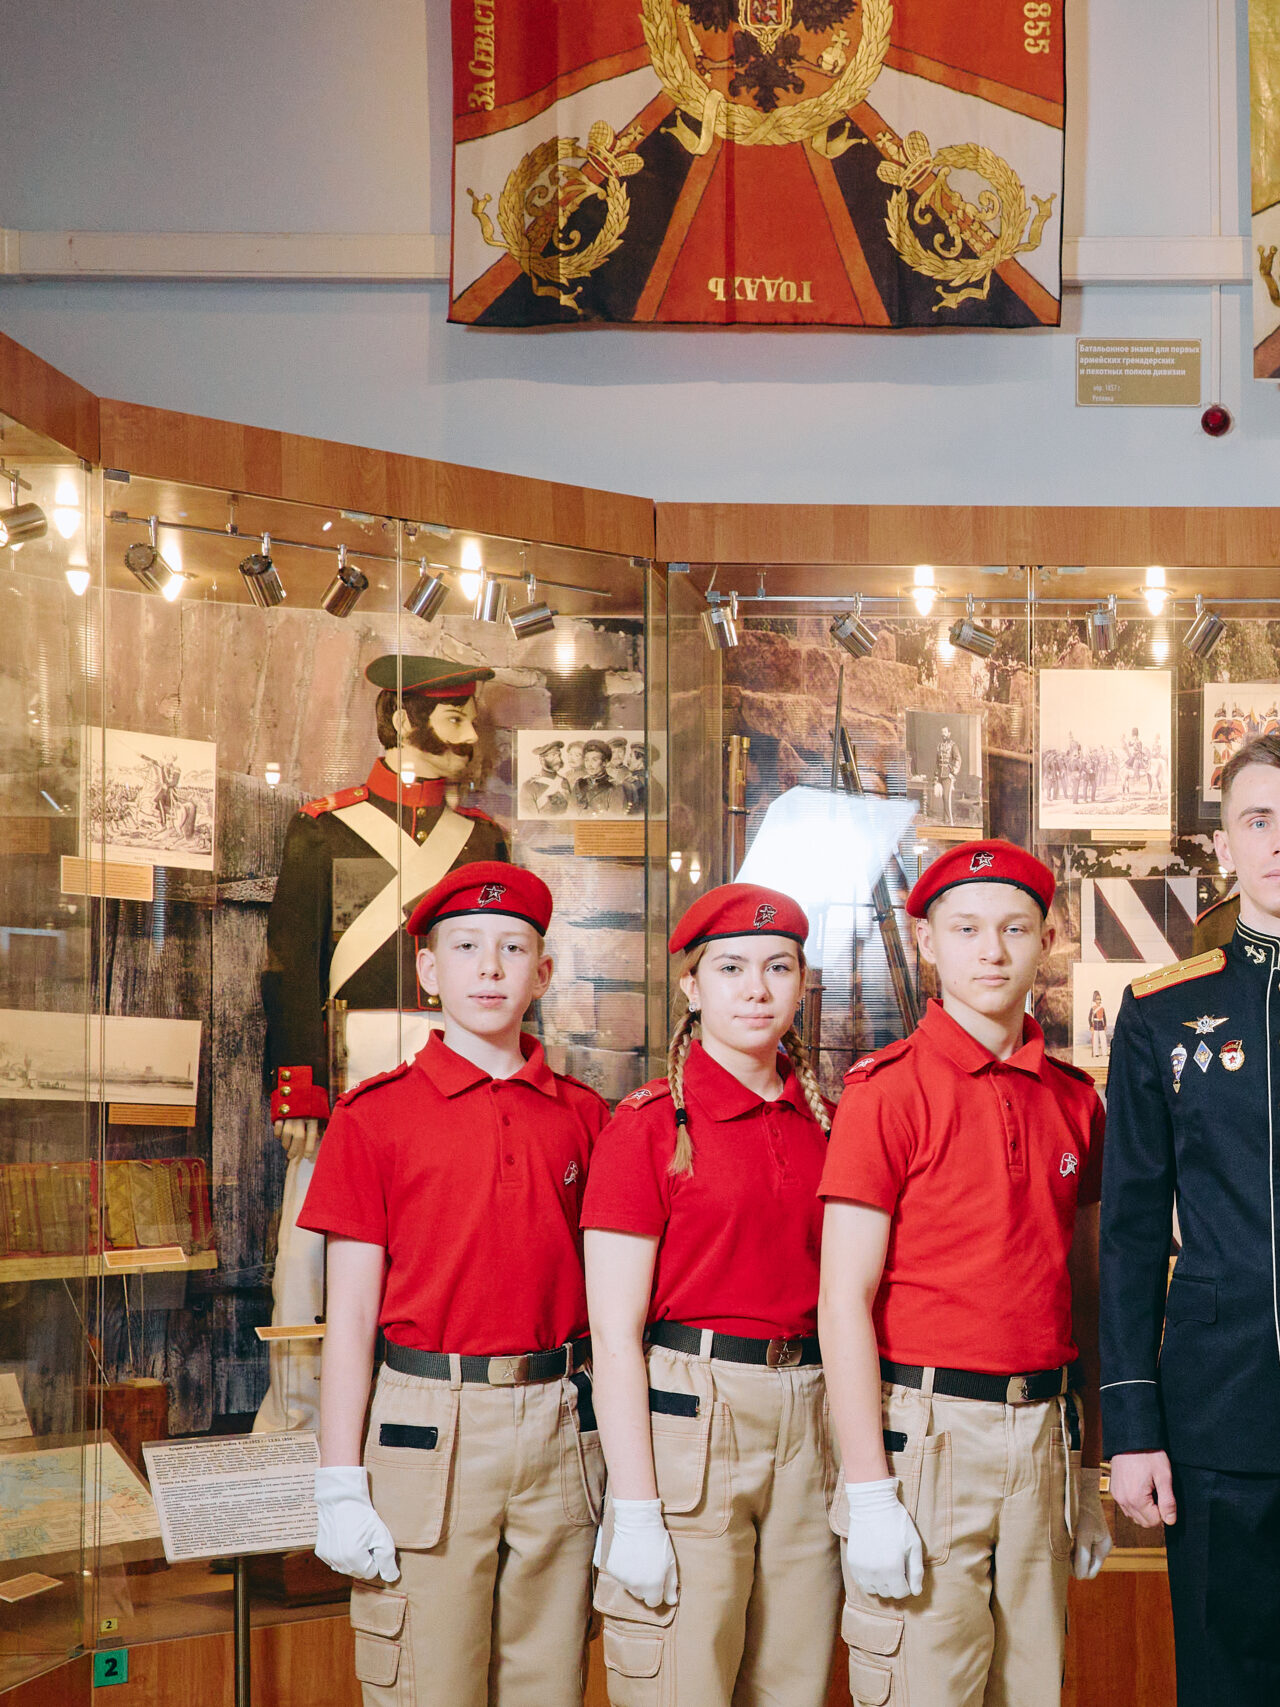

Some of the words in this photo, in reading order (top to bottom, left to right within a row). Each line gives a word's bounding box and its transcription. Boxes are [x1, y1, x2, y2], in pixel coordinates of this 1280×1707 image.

[1079, 344, 1130, 353] Батальонное
[1130, 345, 1154, 353] знамя
[1155, 345, 1169, 354] для
[1170, 345, 1200, 354] первых
[106, 1620, 112, 1629] 2
[104, 1657, 118, 1677] 2
